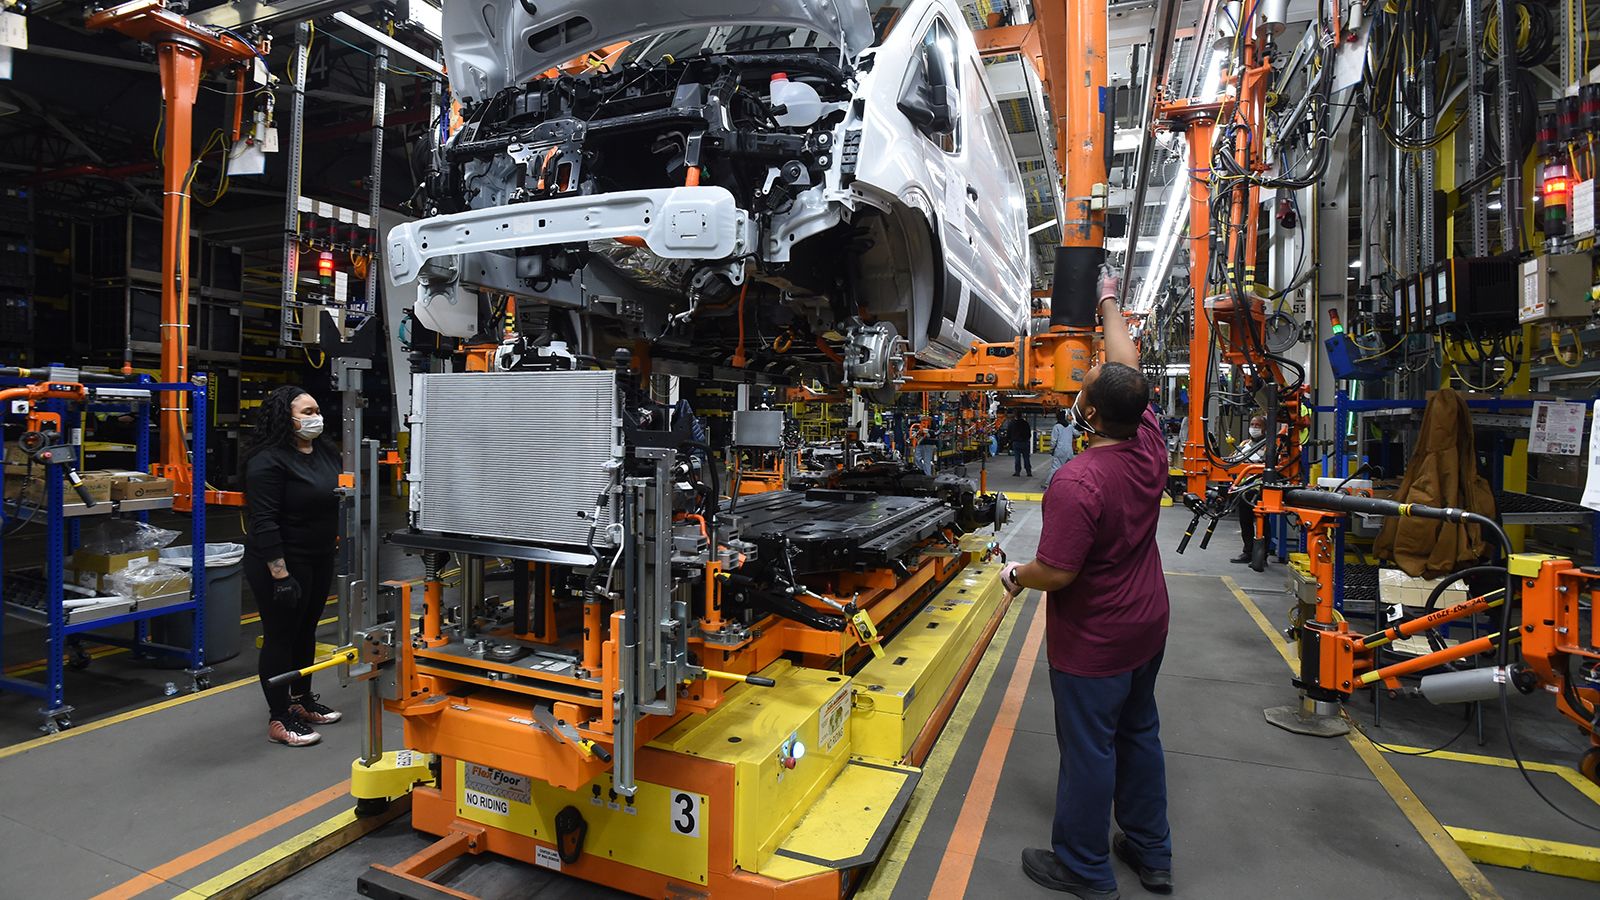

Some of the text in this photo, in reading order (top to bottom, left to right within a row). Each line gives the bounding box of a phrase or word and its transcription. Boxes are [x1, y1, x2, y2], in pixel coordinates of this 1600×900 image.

[310, 45, 328, 79] 4
[1297, 288, 1304, 298] N
[1293, 304, 1306, 314] 53
[493, 772, 520, 785] Floor
[466, 793, 507, 813] NO RIDING
[674, 793, 695, 834] 3
